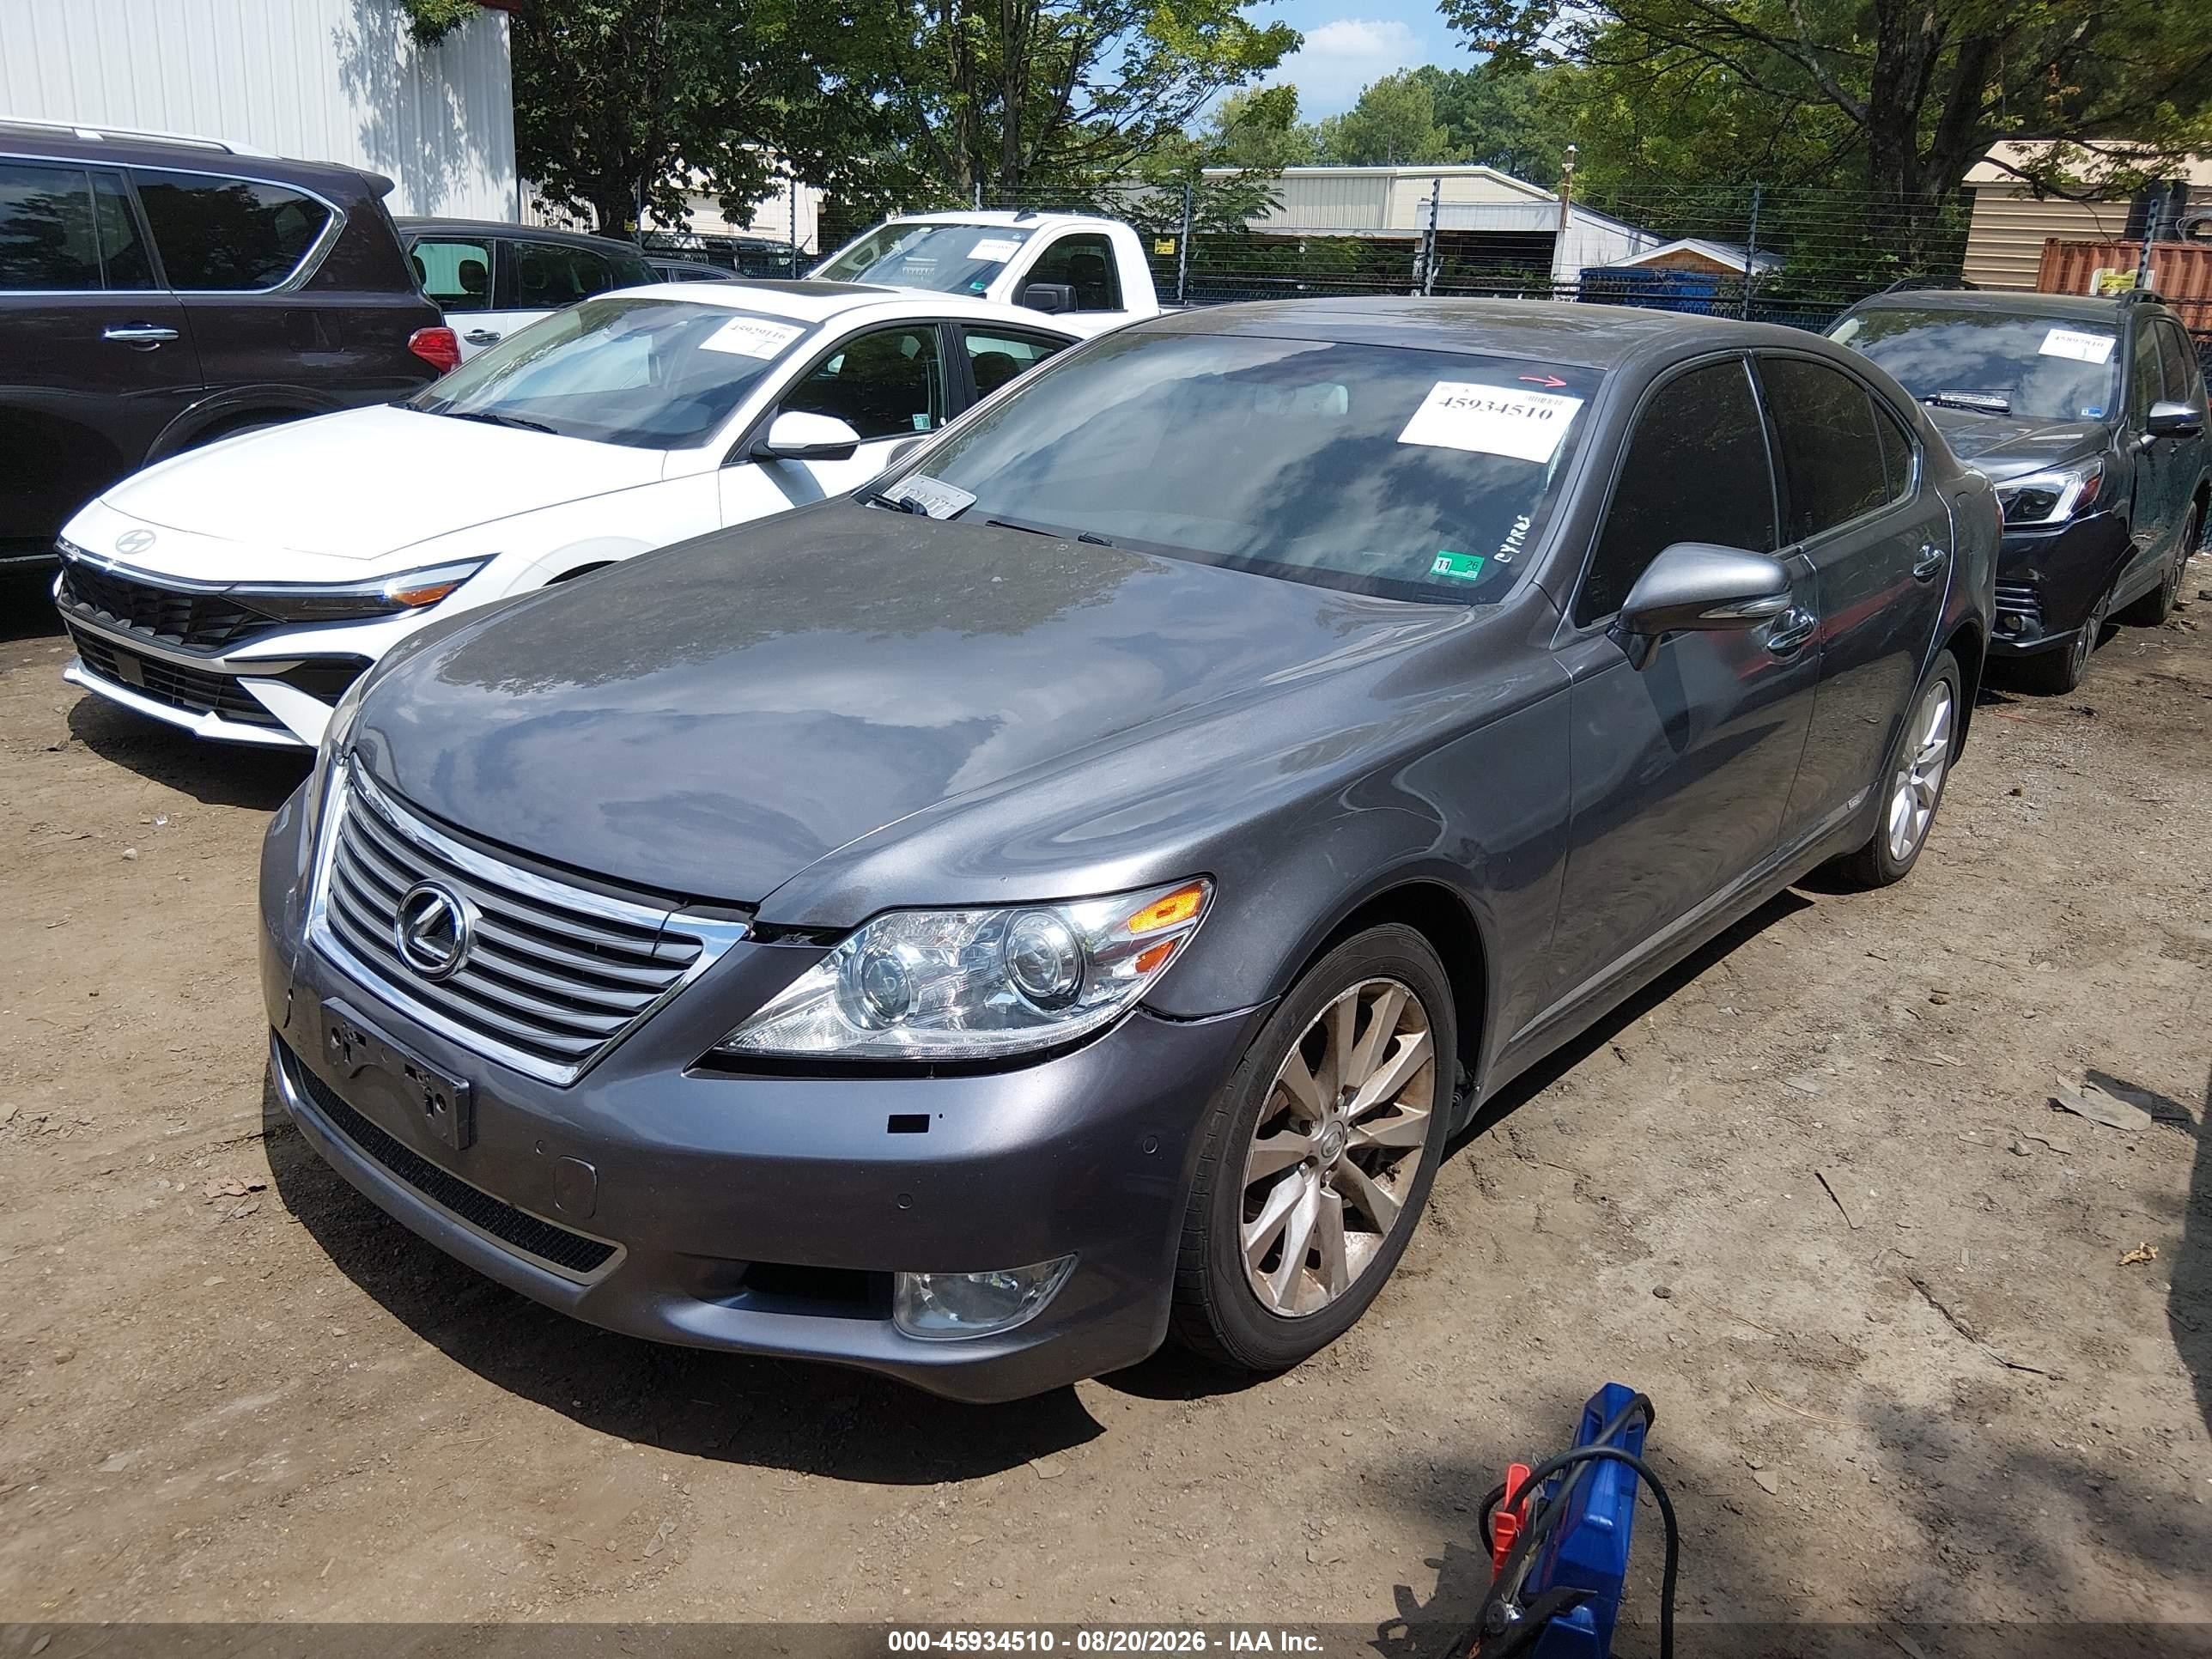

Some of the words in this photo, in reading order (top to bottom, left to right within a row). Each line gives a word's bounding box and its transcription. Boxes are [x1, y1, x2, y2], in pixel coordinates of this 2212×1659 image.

[1437, 396, 1553, 421] 45934510
[1437, 559, 1451, 570] 11
[1465, 560, 1479, 570] 26
